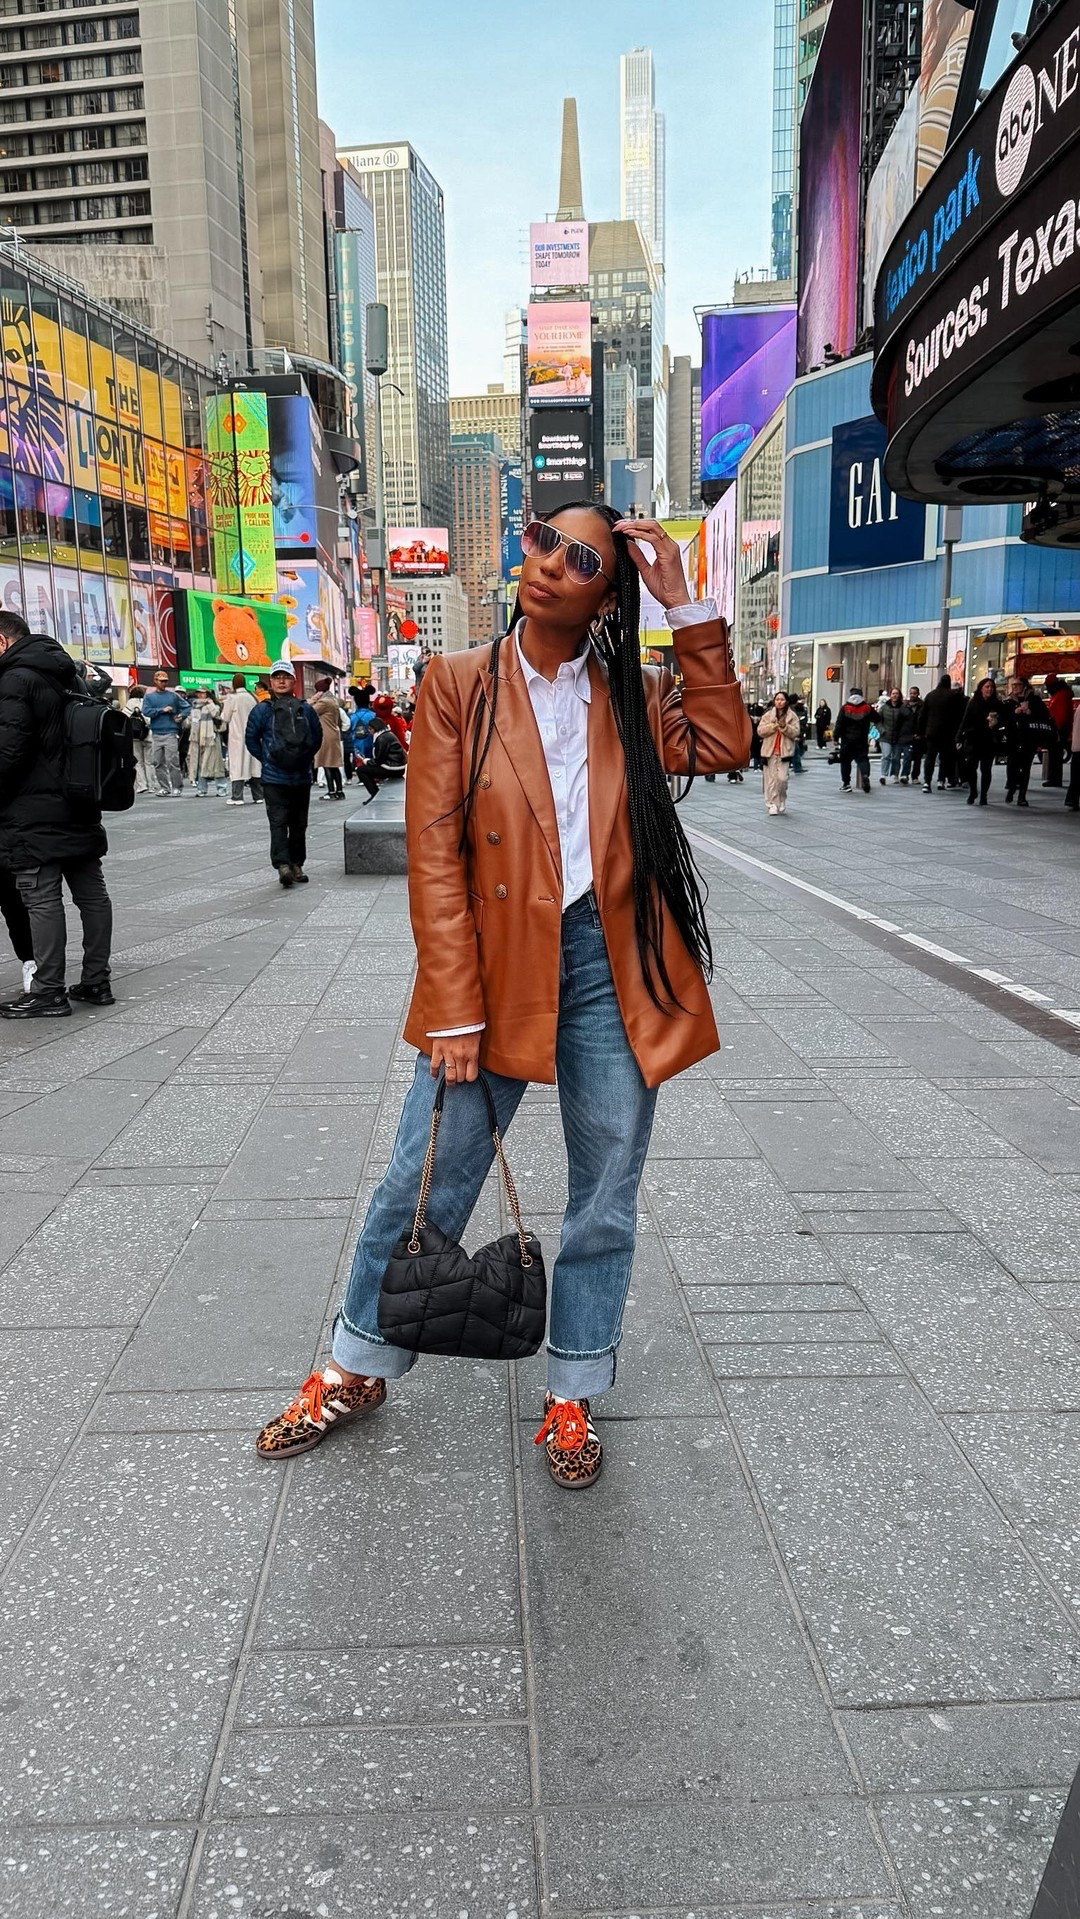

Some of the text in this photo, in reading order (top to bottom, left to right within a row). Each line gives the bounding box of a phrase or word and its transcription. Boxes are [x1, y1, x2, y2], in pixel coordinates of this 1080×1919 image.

[999, 100, 1032, 161] abc
[931, 149, 981, 273] park
[535, 251, 580, 260] SHAPE TOMORROW
[535, 260, 551, 268] TODAY
[546, 243, 580, 251] INVESTMENTS
[339, 246, 355, 346] TIMES
[904, 198, 1080, 397] Sources: Texa
[106, 376, 139, 416] THE
[75, 400, 129, 469] LION
[546, 456, 587, 467] SmartThings
[37, 585, 149, 654] NEWS
